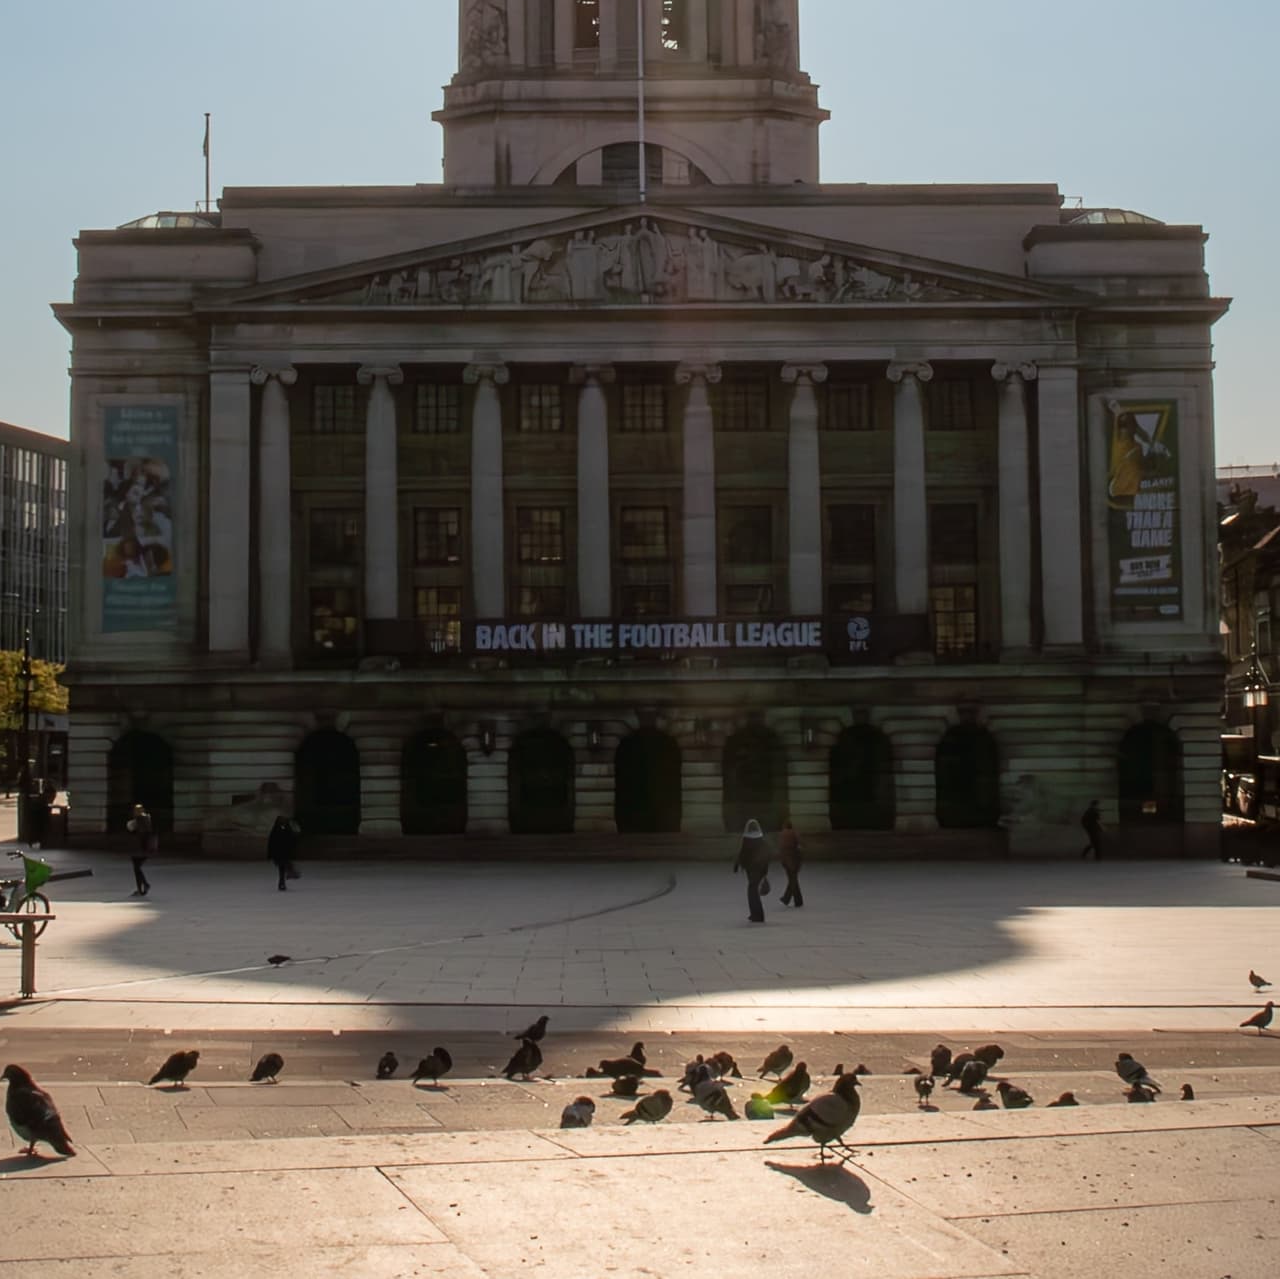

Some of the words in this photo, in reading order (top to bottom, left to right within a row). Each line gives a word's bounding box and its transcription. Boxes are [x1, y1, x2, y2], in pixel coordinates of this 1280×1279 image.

[475, 623, 535, 650] BACK
[541, 622, 566, 649] IN
[571, 622, 613, 649] THE
[618, 621, 730, 648] FOOTBALL
[734, 621, 821, 648] LEAGUE
